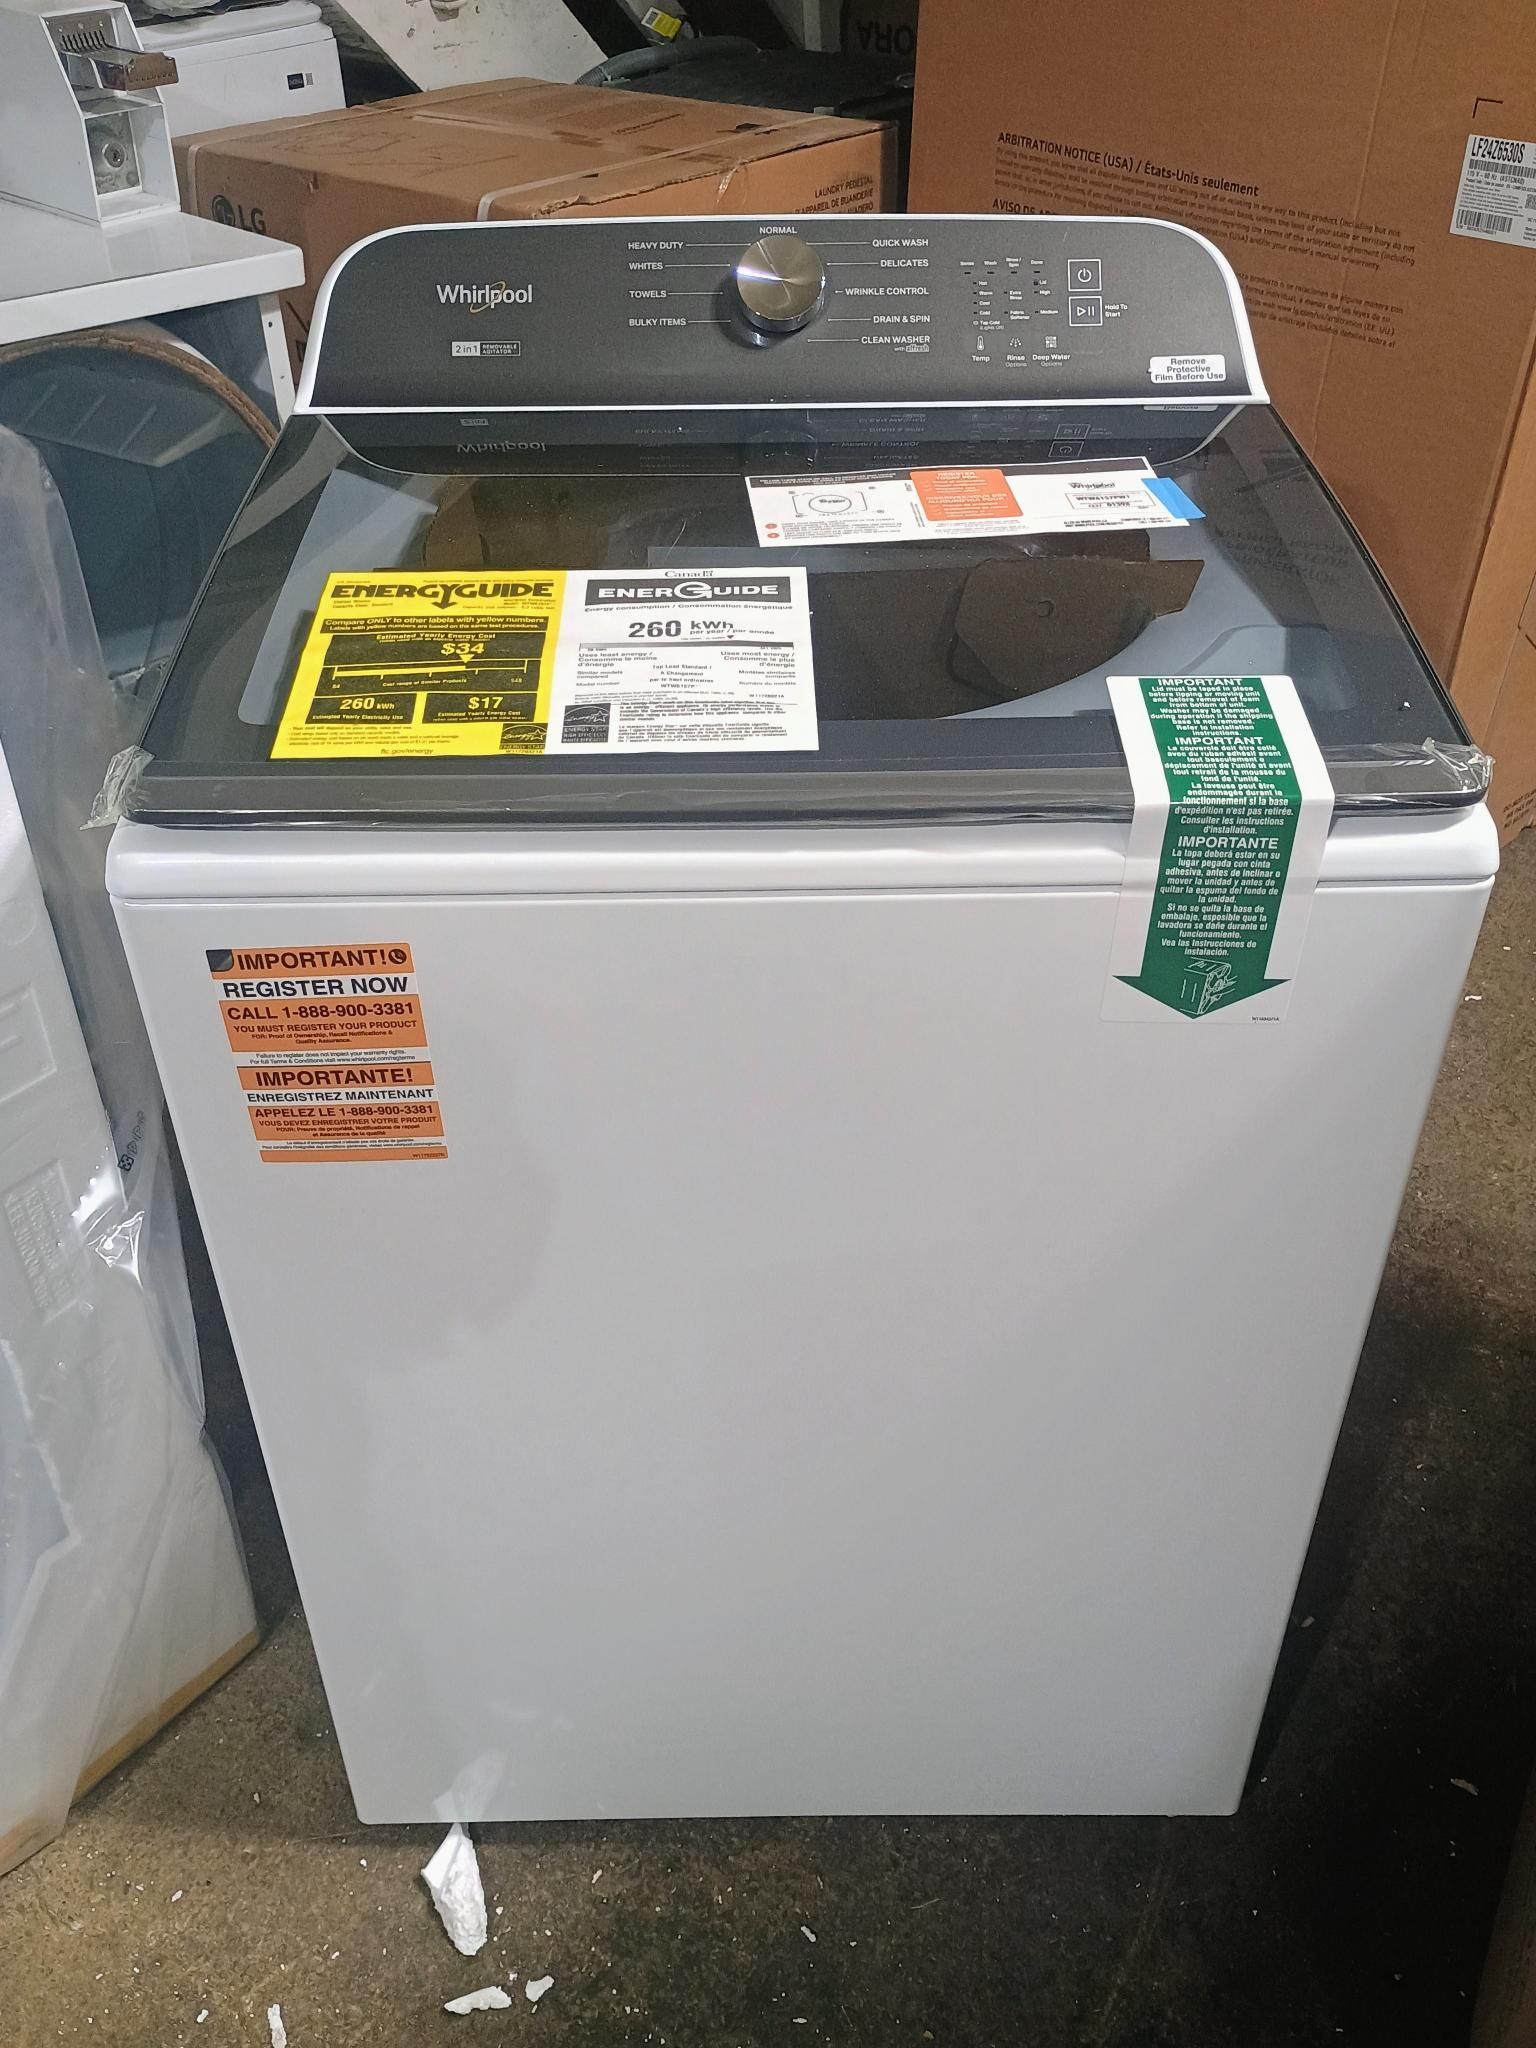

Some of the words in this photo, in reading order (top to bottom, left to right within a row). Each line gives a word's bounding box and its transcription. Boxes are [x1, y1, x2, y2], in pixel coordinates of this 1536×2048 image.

[998, 132, 1062, 156] ARBITRATION
[1064, 146, 1101, 164] NOTICE
[1104, 152, 1133, 173] (USA)
[1136, 162, 1142, 173] /
[1144, 160, 1198, 184] États-Unis
[1202, 177, 1259, 196] seulement
[992, 198, 1022, 214] AVISO
[238, 205, 266, 234] LG
[628, 242, 658, 250] HEAVY
[872, 239, 899, 247] QUICK
[436, 284, 532, 309] Whirlpool
[629, 318, 657, 326] BULKY
[861, 336, 889, 344] CLEAN
[1167, 365, 1210, 373] Protective
[331, 582, 554, 599] ENERGYGUIDE
[628, 620, 681, 638] 260
[690, 620, 733, 630] kWh
[441, 643, 485, 656] $34
[340, 698, 374, 710] 260
[377, 702, 394, 710] kWh
[469, 697, 503, 709] $17
[1175, 737, 1263, 745] IMPORTANT
[1183, 797, 1246, 806] fonctionnement
[1259, 797, 1266, 805] la
[1268, 797, 1288, 806] base
[1175, 806, 1223, 815] d'expédition
[1226, 807, 1245, 815] n'est
[1264, 807, 1293, 815] retirée.
[1181, 816, 1220, 824] Consulter
[1236, 817, 1284, 826] instructions
[1204, 826, 1257, 835] d'installation.
[1178, 836, 1279, 849] IMPORTANTE
[1184, 849, 1202, 858] tapa
[1204, 850, 1233, 858] deberá
[1235, 851, 1256, 859] estar
[1178, 859, 1199, 867] lugar
[1201, 860, 1231, 868] pegada
[1251, 860, 1270, 868] cinta
[1165, 868, 1203, 877] adhesiva,
[1206, 869, 1228, 877] antes
[1230, 869, 1240, 877] de
[1243, 869, 1273, 878] inclinar
[1233, 879, 1239, 888] y
[237, 949, 386, 971] IMPORTANT!
[222, 979, 344, 998] REGISTER
[351, 977, 408, 994] NOW
[227, 1007, 278, 1020] CALL
[284, 1002, 414, 1019] 1-888-900-3381
[233, 1025, 255, 1033] YOU
[257, 1024, 284, 1032] MUST
[286, 1023, 337, 1032] REGISTER
[339, 1021, 367, 1030] YOUR
[369, 1020, 416, 1029] PRODUCT
[255, 1068, 413, 1086] IMPORTANTE!
[247, 1092, 342, 1103] ENREGISTREZ
[345, 1089, 434, 1101] MAINTENANT
[255, 1108, 315, 1117] APPELEZ
[320, 1107, 335, 1116] LE
[340, 1105, 433, 1115] 1-888-900-3381
